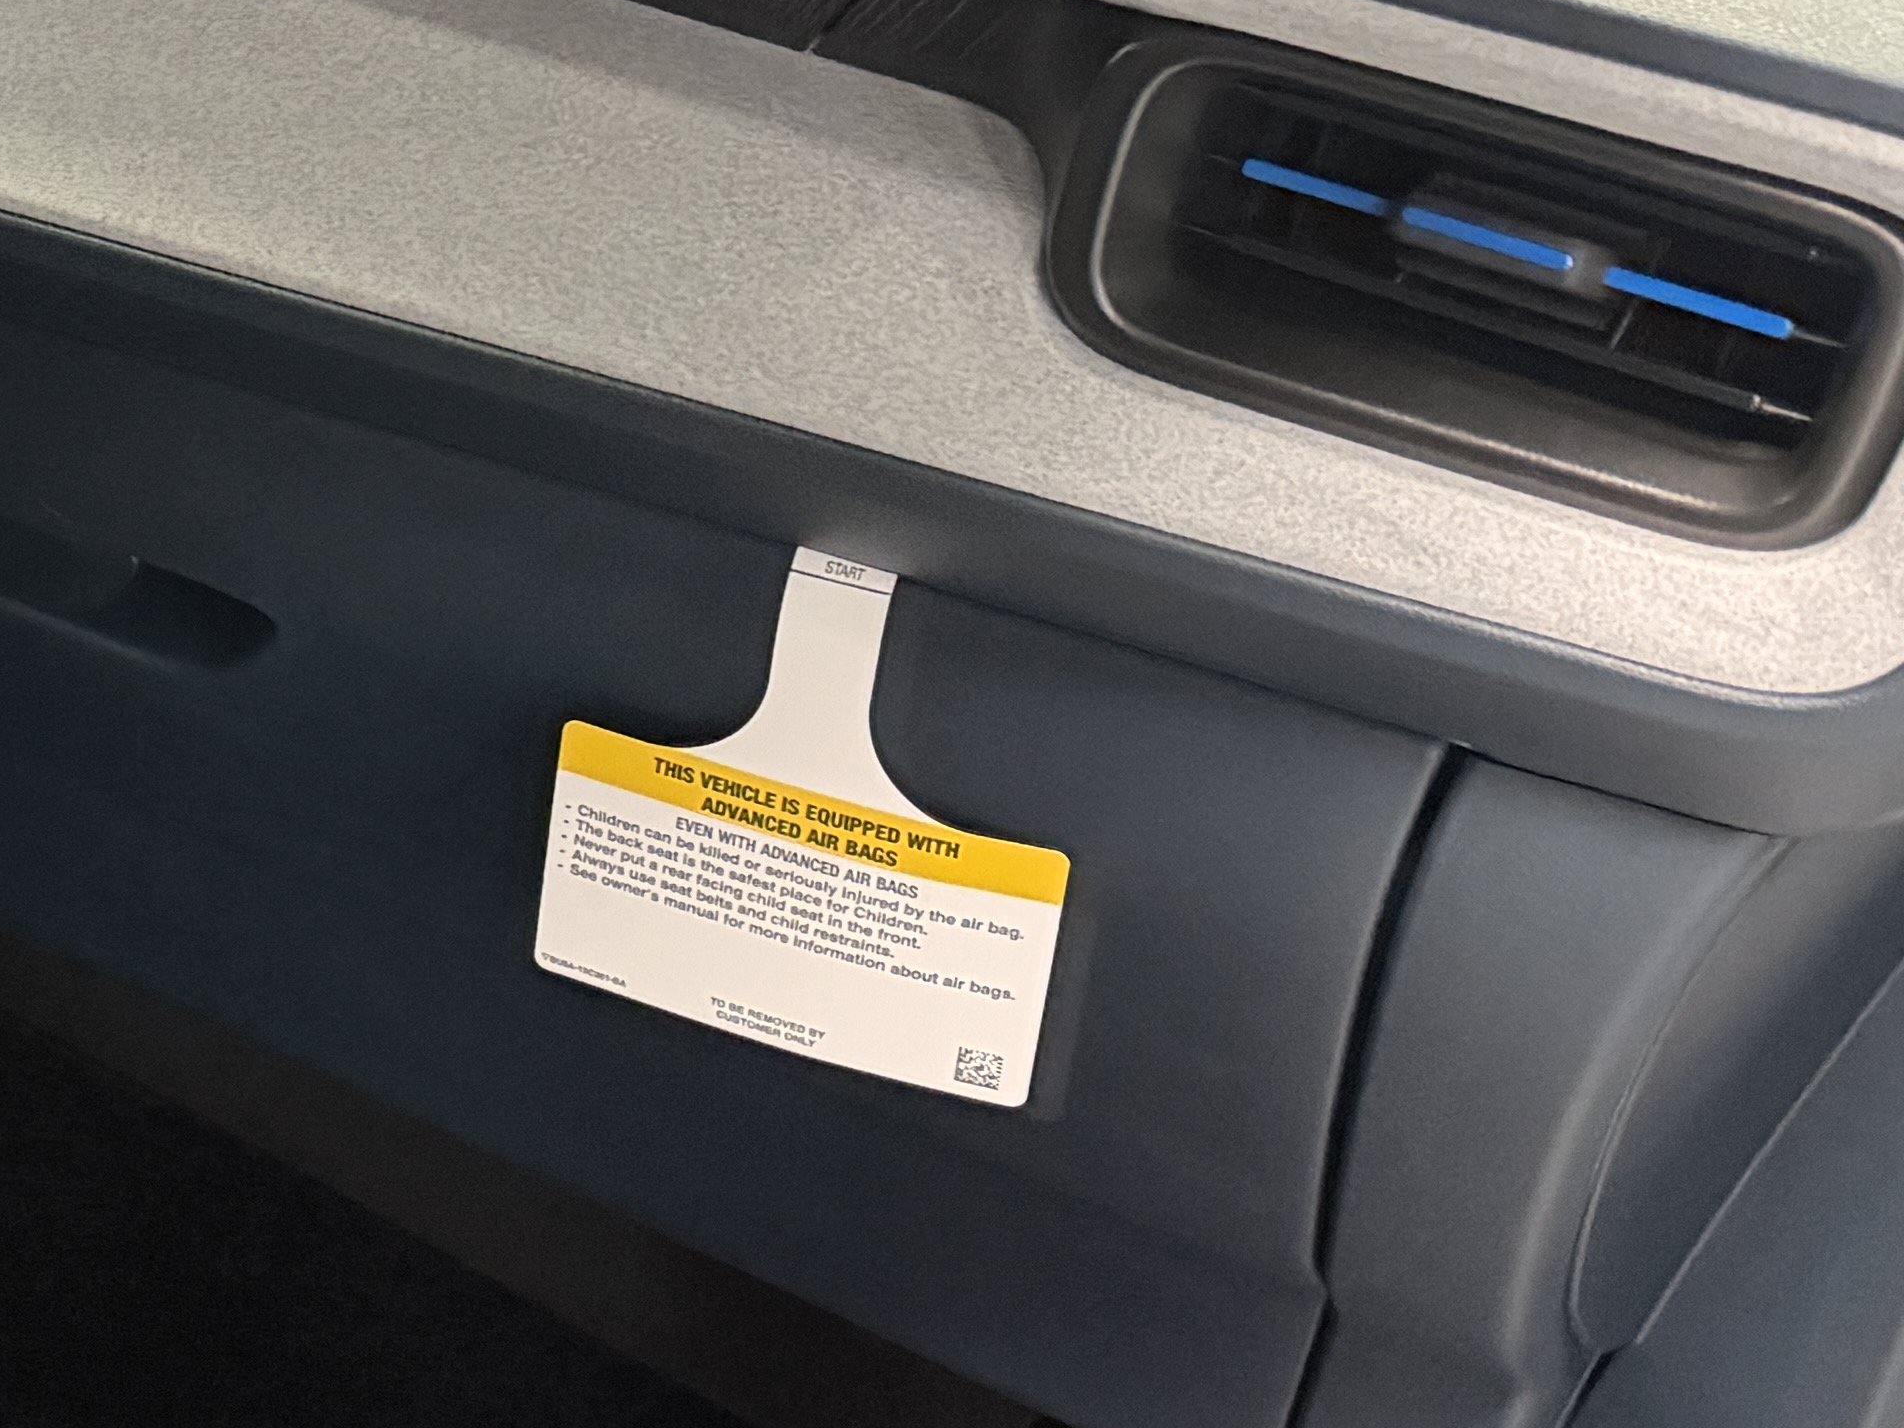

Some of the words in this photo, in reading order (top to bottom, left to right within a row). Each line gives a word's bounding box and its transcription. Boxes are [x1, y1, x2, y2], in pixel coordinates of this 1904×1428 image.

[824, 560, 867, 581] START
[653, 756, 695, 784] THIS
[699, 771, 777, 809] VEHICLE
[780, 795, 800, 815] IS
[804, 803, 901, 844] EQUIPPED
[907, 831, 960, 859] WITH
[675, 816, 714, 839] EVEN
[717, 828, 756, 853] WITH
[759, 843, 840, 877] ADVANCED
[842, 868, 871, 887] AIR
[875, 876, 918, 899] BAGS
[700, 796, 801, 839] ADVANCED
[805, 828, 839, 851] AIR
[844, 838, 898, 867] BAGS
[571, 849, 625, 876] Always
[628, 869, 656, 886] use
[659, 879, 692, 898] seat
[695, 888, 733, 910] belts
[736, 904, 767, 921] and
[770, 914, 809, 934] child
[812, 927, 895, 958] restraints.
[573, 833, 617, 857] Never
[619, 851, 645, 867] put
[648, 860, 658, 871] a
[661, 864, 693, 881] rear
[695, 873, 743, 901] facing
[746, 891, 786, 912] child
[789, 905, 824, 923] seat
[827, 913, 843, 929] in
[847, 920, 873, 937] the
[877, 927, 921, 950] front.
[575, 818, 603, 838] The
[606, 828, 643, 851] back
[646, 844, 679, 862] seat
[682, 852, 696, 868] is
[700, 859, 725, 876] the
[728, 870, 776, 893] safest
[778, 885, 822, 907] place
[826, 898, 850, 914] for
[853, 905, 928, 936] Children.
[577, 803, 640, 834] Children
[643, 827, 672, 844] can
[675, 835, 695, 851] be
[698, 842, 740, 866] killed
[743, 859, 761, 871] or
[764, 865, 838, 897] seriously
[841, 886, 899, 912] injured
[903, 903, 925, 921] by
[928, 910, 956, 925] the
[960, 917, 984, 930] air
[987, 920, 1024, 941] bag.
[569, 863, 597, 882] See
[600, 875, 659, 902] owner's
[663, 895, 719, 922] manual
[723, 913, 745, 929] for
[748, 923, 789, 944] more
[792, 934, 886, 972] information
[889, 964, 939, 985] about
[942, 976, 965, 990] air
[968, 980, 1015, 1001] bags.
[710, 995, 726, 1009] TO
[728, 1001, 744, 1015] BE
[747, 1008, 806, 1034] REMOVED
[808, 1027, 826, 1040] BY
[715, 1009, 781, 1038] CUSTOMER
[783, 1031, 816, 1047] ONLY
